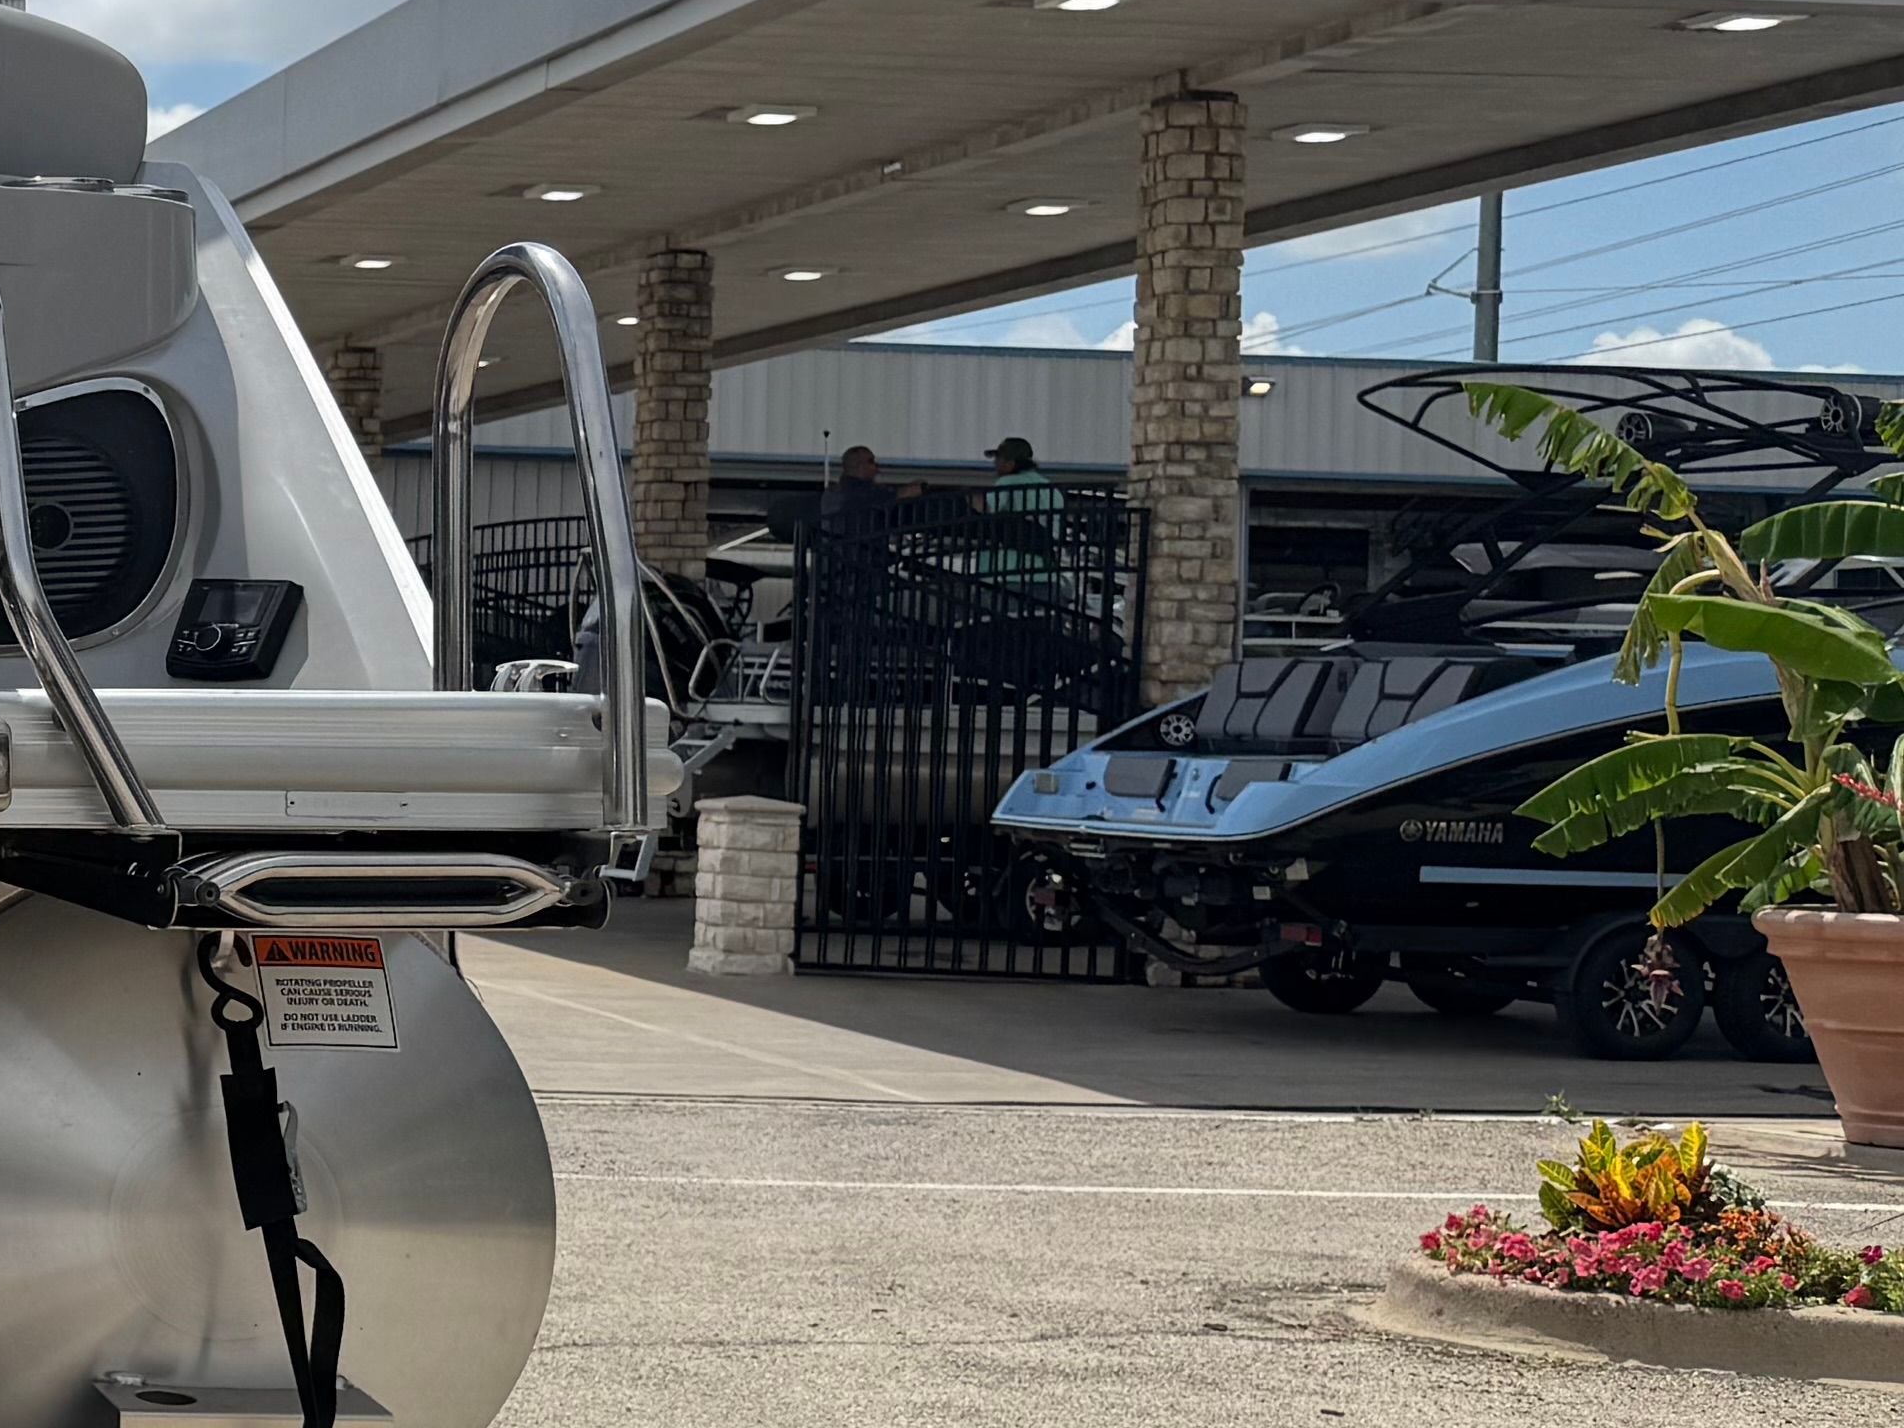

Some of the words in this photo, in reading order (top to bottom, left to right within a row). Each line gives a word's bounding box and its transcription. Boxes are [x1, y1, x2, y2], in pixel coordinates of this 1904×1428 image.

[1425, 820, 1504, 844] YAMAHA
[289, 940, 376, 963] WARNING
[275, 978, 322, 987] ROTATING
[323, 979, 374, 989] PROPELLER
[280, 988, 301, 996] CAN
[302, 988, 332, 997] CAUSE
[334, 988, 373, 998] SERIOUS
[286, 997, 319, 1006] INJURY
[321, 998, 336, 1006] OR
[283, 1013, 299, 1022] DO
[300, 1013, 319, 1022] NOT
[321, 1013, 339, 1023] USE
[341, 1014, 378, 1023] LADDER
[292, 1023, 327, 1032] ENGINE
[328, 1024, 337, 1032] IS
